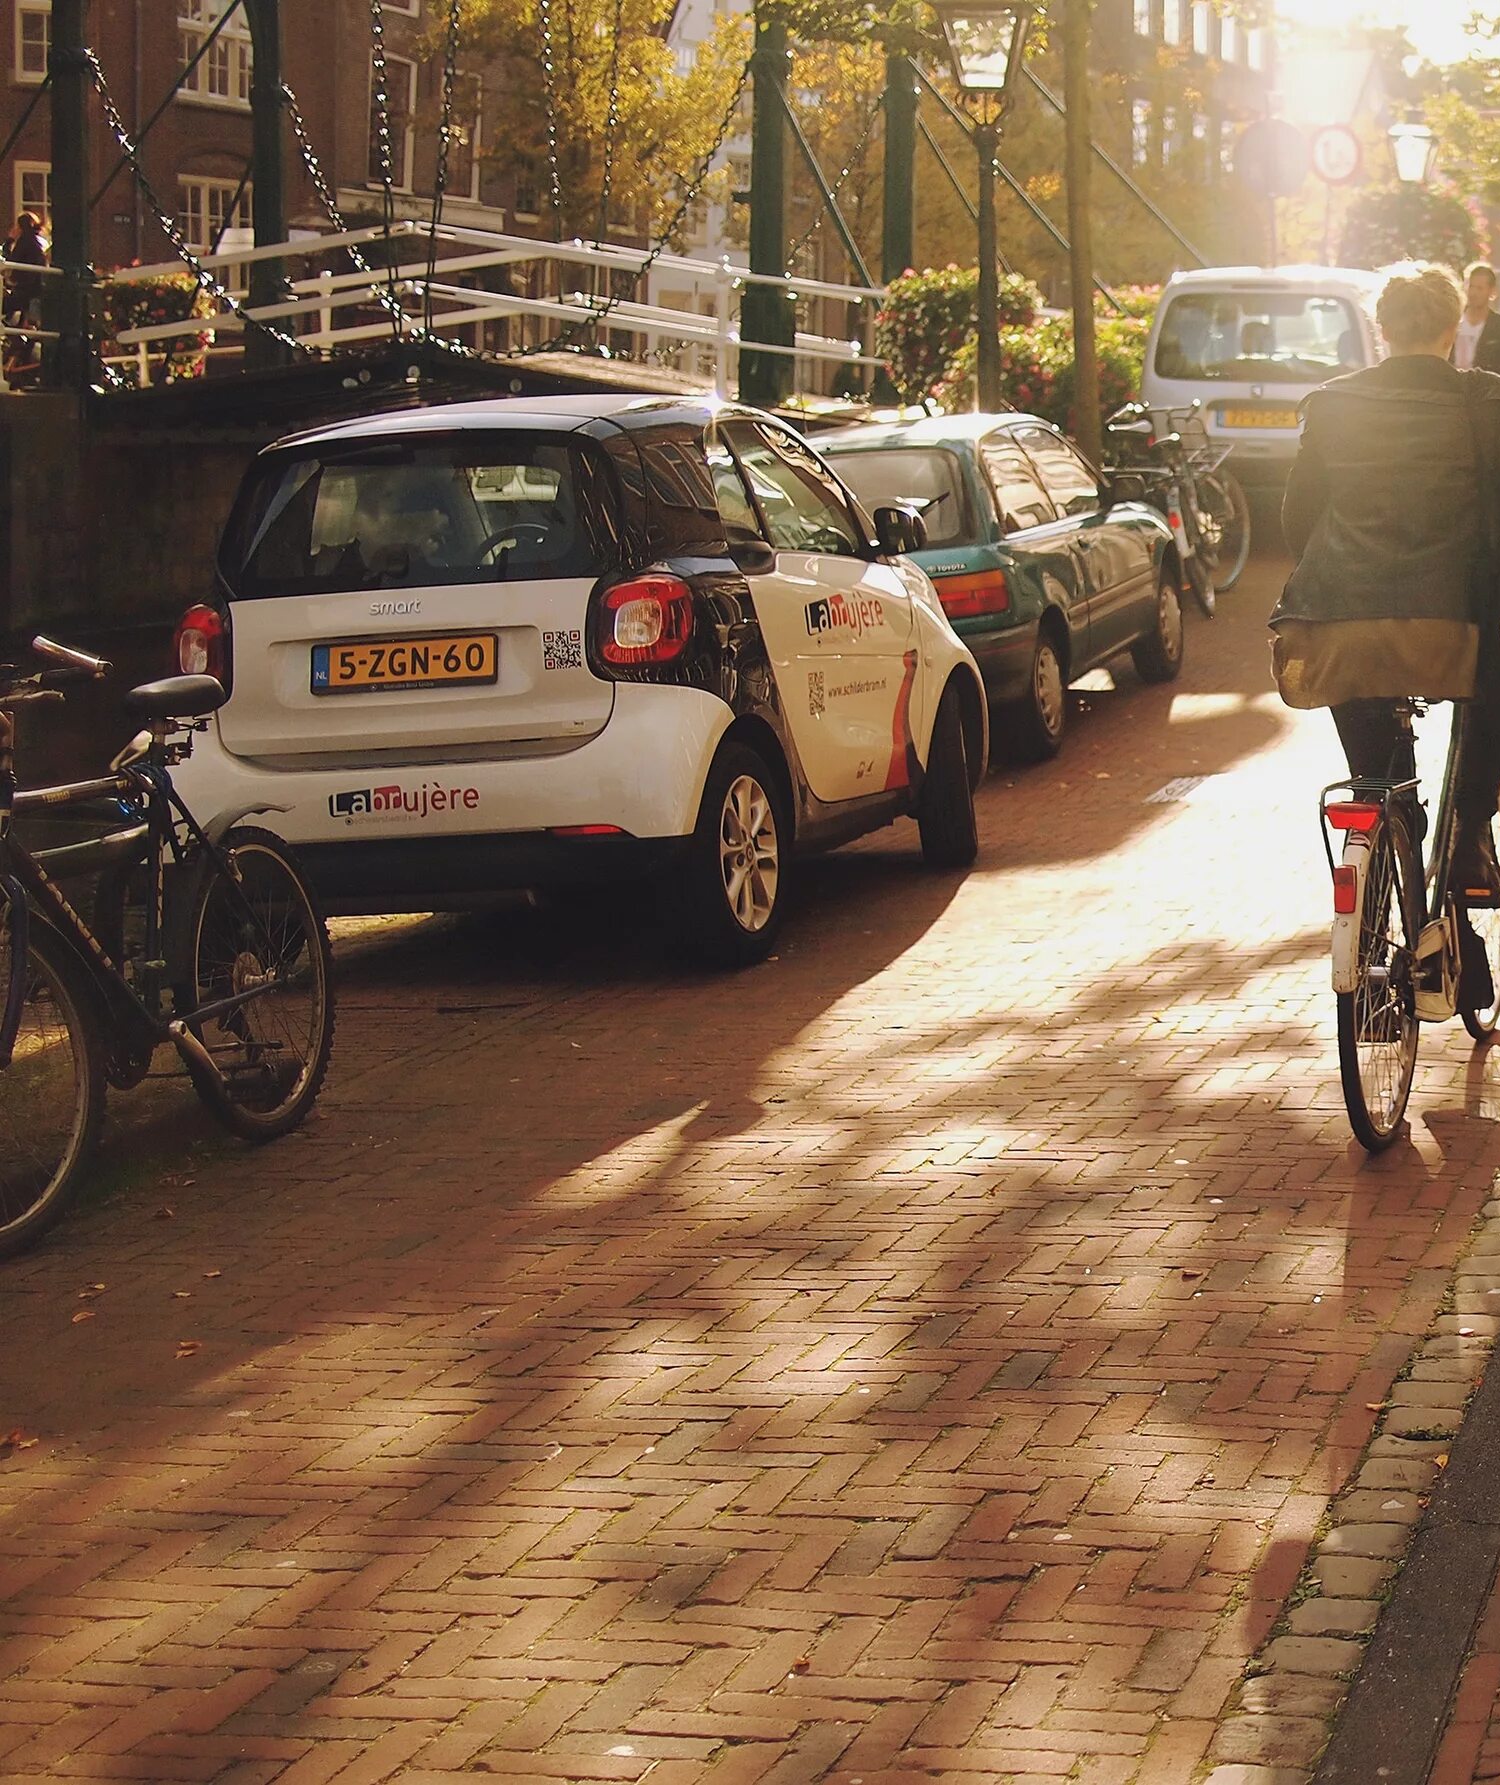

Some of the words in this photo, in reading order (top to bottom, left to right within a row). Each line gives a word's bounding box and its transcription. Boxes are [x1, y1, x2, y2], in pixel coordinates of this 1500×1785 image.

[937, 563, 967, 573] TOYOTA
[368, 599, 422, 616] smart
[339, 642, 484, 680] 5-ZGN-60
[315, 670, 328, 680] NL
[329, 782, 480, 818] Labrujère
